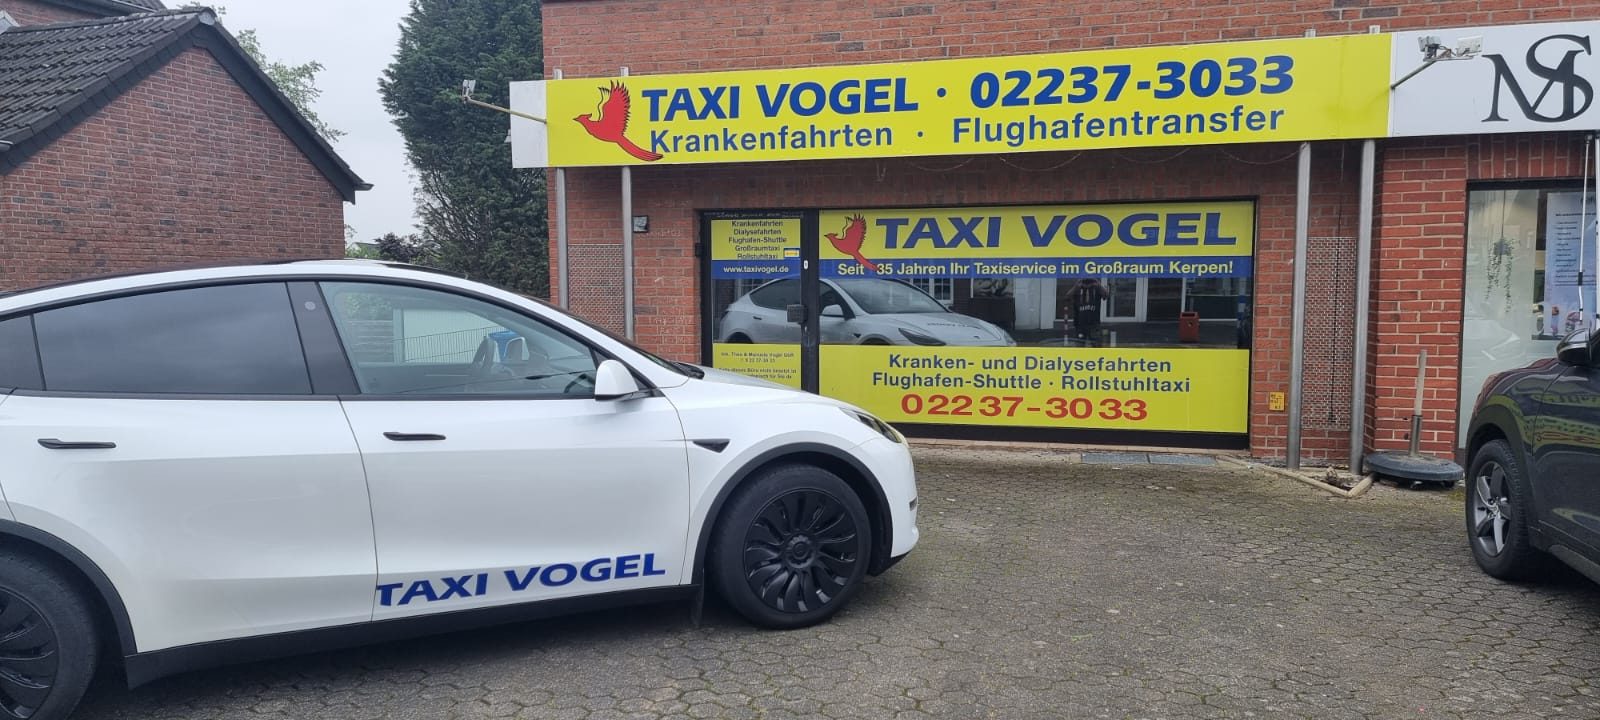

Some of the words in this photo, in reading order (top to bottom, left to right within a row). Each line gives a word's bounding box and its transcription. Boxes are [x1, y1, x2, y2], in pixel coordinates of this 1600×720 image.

[641, 86, 740, 122] TAXI
[755, 77, 919, 118] VOGEL
[970, 55, 1295, 109] 02237-3033
[650, 124, 893, 154] Krankenfahrten
[953, 105, 1286, 148] Flughafentransfer
[728, 236, 787, 244] Flughafen-Shuttle
[733, 228, 782, 236] Dialysefahrten
[875, 216, 1002, 249] TAXI
[1021, 212, 1237, 248] VOGEL
[723, 265, 789, 274] www.taxivogel.de
[837, 263, 865, 276] Seit
[876, 263, 893, 276] 35
[897, 263, 946, 276] Jahren
[950, 262, 970, 275] Ihr
[974, 262, 1057, 275] Taxiservice
[1061, 261, 1080, 274] im
[1084, 261, 1164, 275] Großraum
[1169, 260, 1233, 277] Kerpen!
[889, 353, 975, 370] Kranken-
[982, 356, 1017, 371] und
[1025, 355, 1172, 374] Dialysefahrten
[872, 371, 1042, 390] Flughafen-Shuttle
[1061, 375, 1191, 393] Rollstuhltaxi
[376, 572, 488, 607] TAXI
[503, 552, 666, 592] VOGEL
